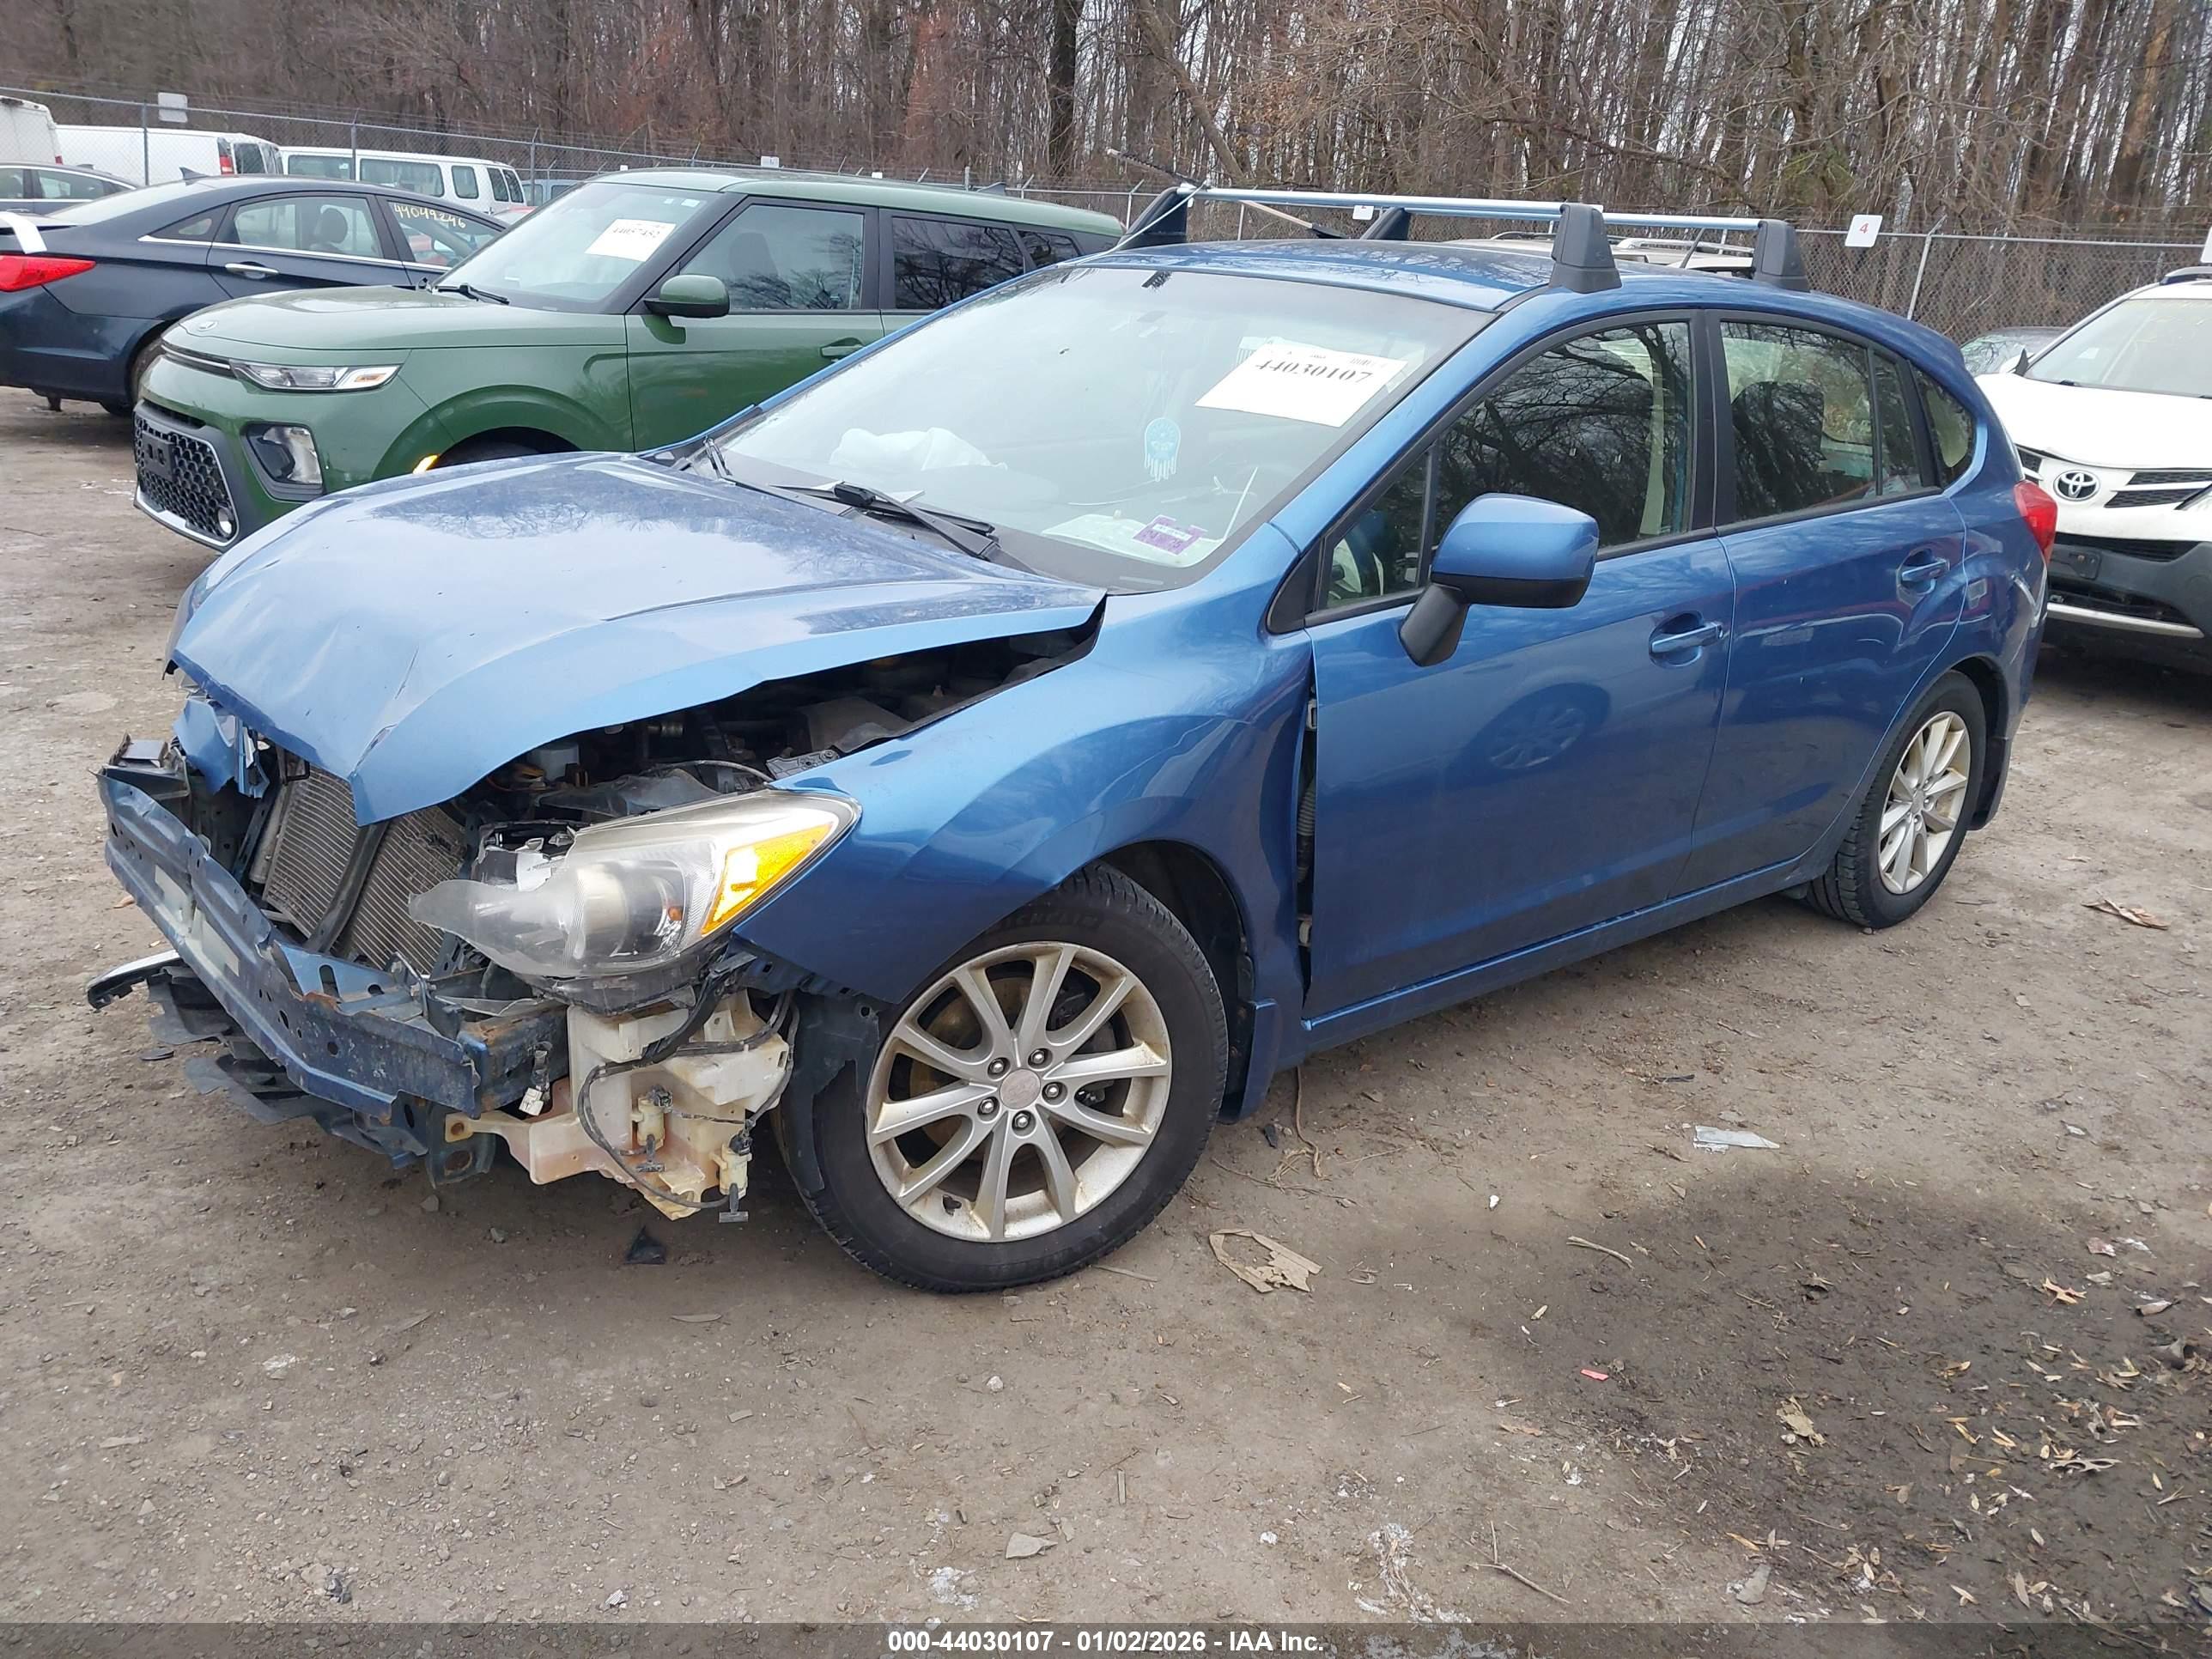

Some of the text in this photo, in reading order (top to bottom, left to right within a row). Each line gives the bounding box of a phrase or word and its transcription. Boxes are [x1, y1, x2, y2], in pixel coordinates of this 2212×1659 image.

[394, 203, 466, 228] 44049246
[1859, 222, 1869, 234] 4
[1255, 359, 1374, 383] 44030107
